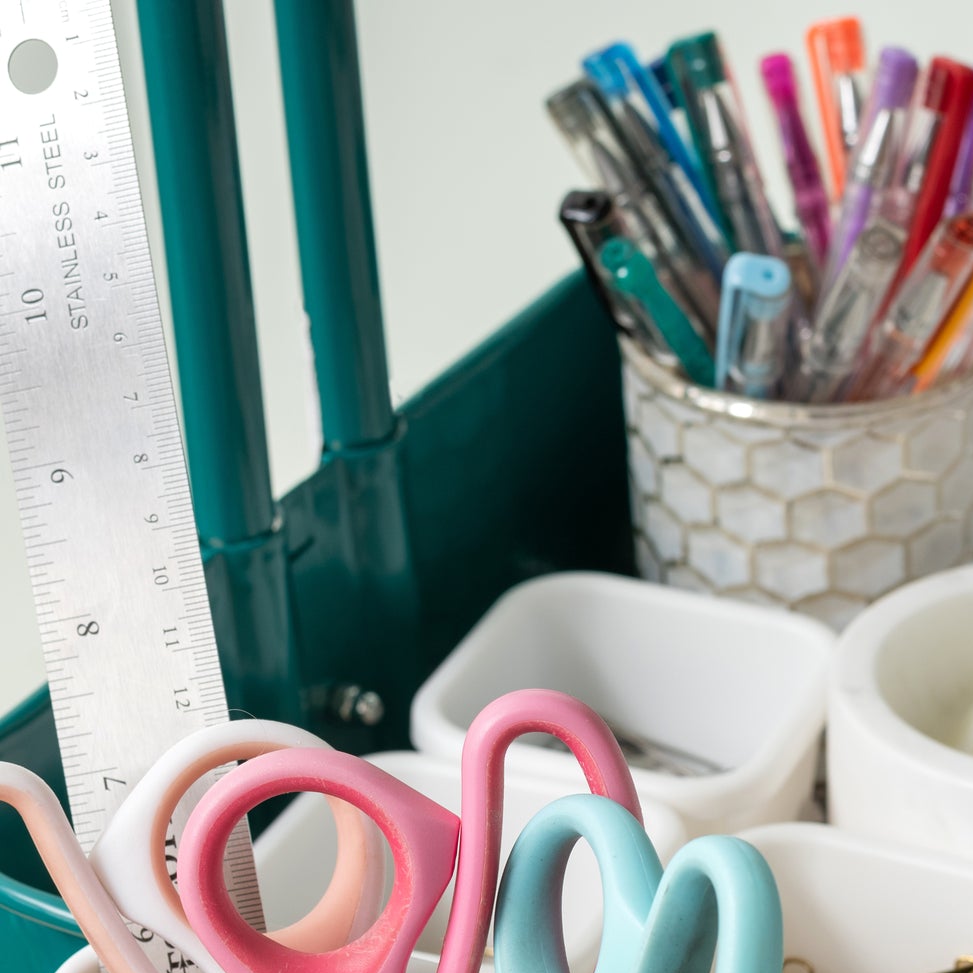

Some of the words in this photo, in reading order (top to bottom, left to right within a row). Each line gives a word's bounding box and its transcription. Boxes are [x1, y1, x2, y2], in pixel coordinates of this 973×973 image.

[74, 89, 89, 100] 2
[0, 136, 22, 170] 11
[39, 113, 67, 190] STEEL
[84, 151, 99, 160] 3
[94, 210, 109, 222] 4
[52, 201, 89, 330] STAINLESS
[103, 271, 119, 282] 5
[20, 288, 49, 325] 10
[113, 332, 128, 343] 6
[123, 390, 138, 402] 7
[133, 453, 149, 464] 8
[50, 468, 74, 484] 9
[143, 513, 159, 524] 9
[152, 565, 169, 586] 10
[76, 620, 100, 637] 8
[163, 626, 180, 647] 11
[173, 687, 191, 710] 12
[103, 776, 127, 792] 7
[132, 927, 154, 943] 6
